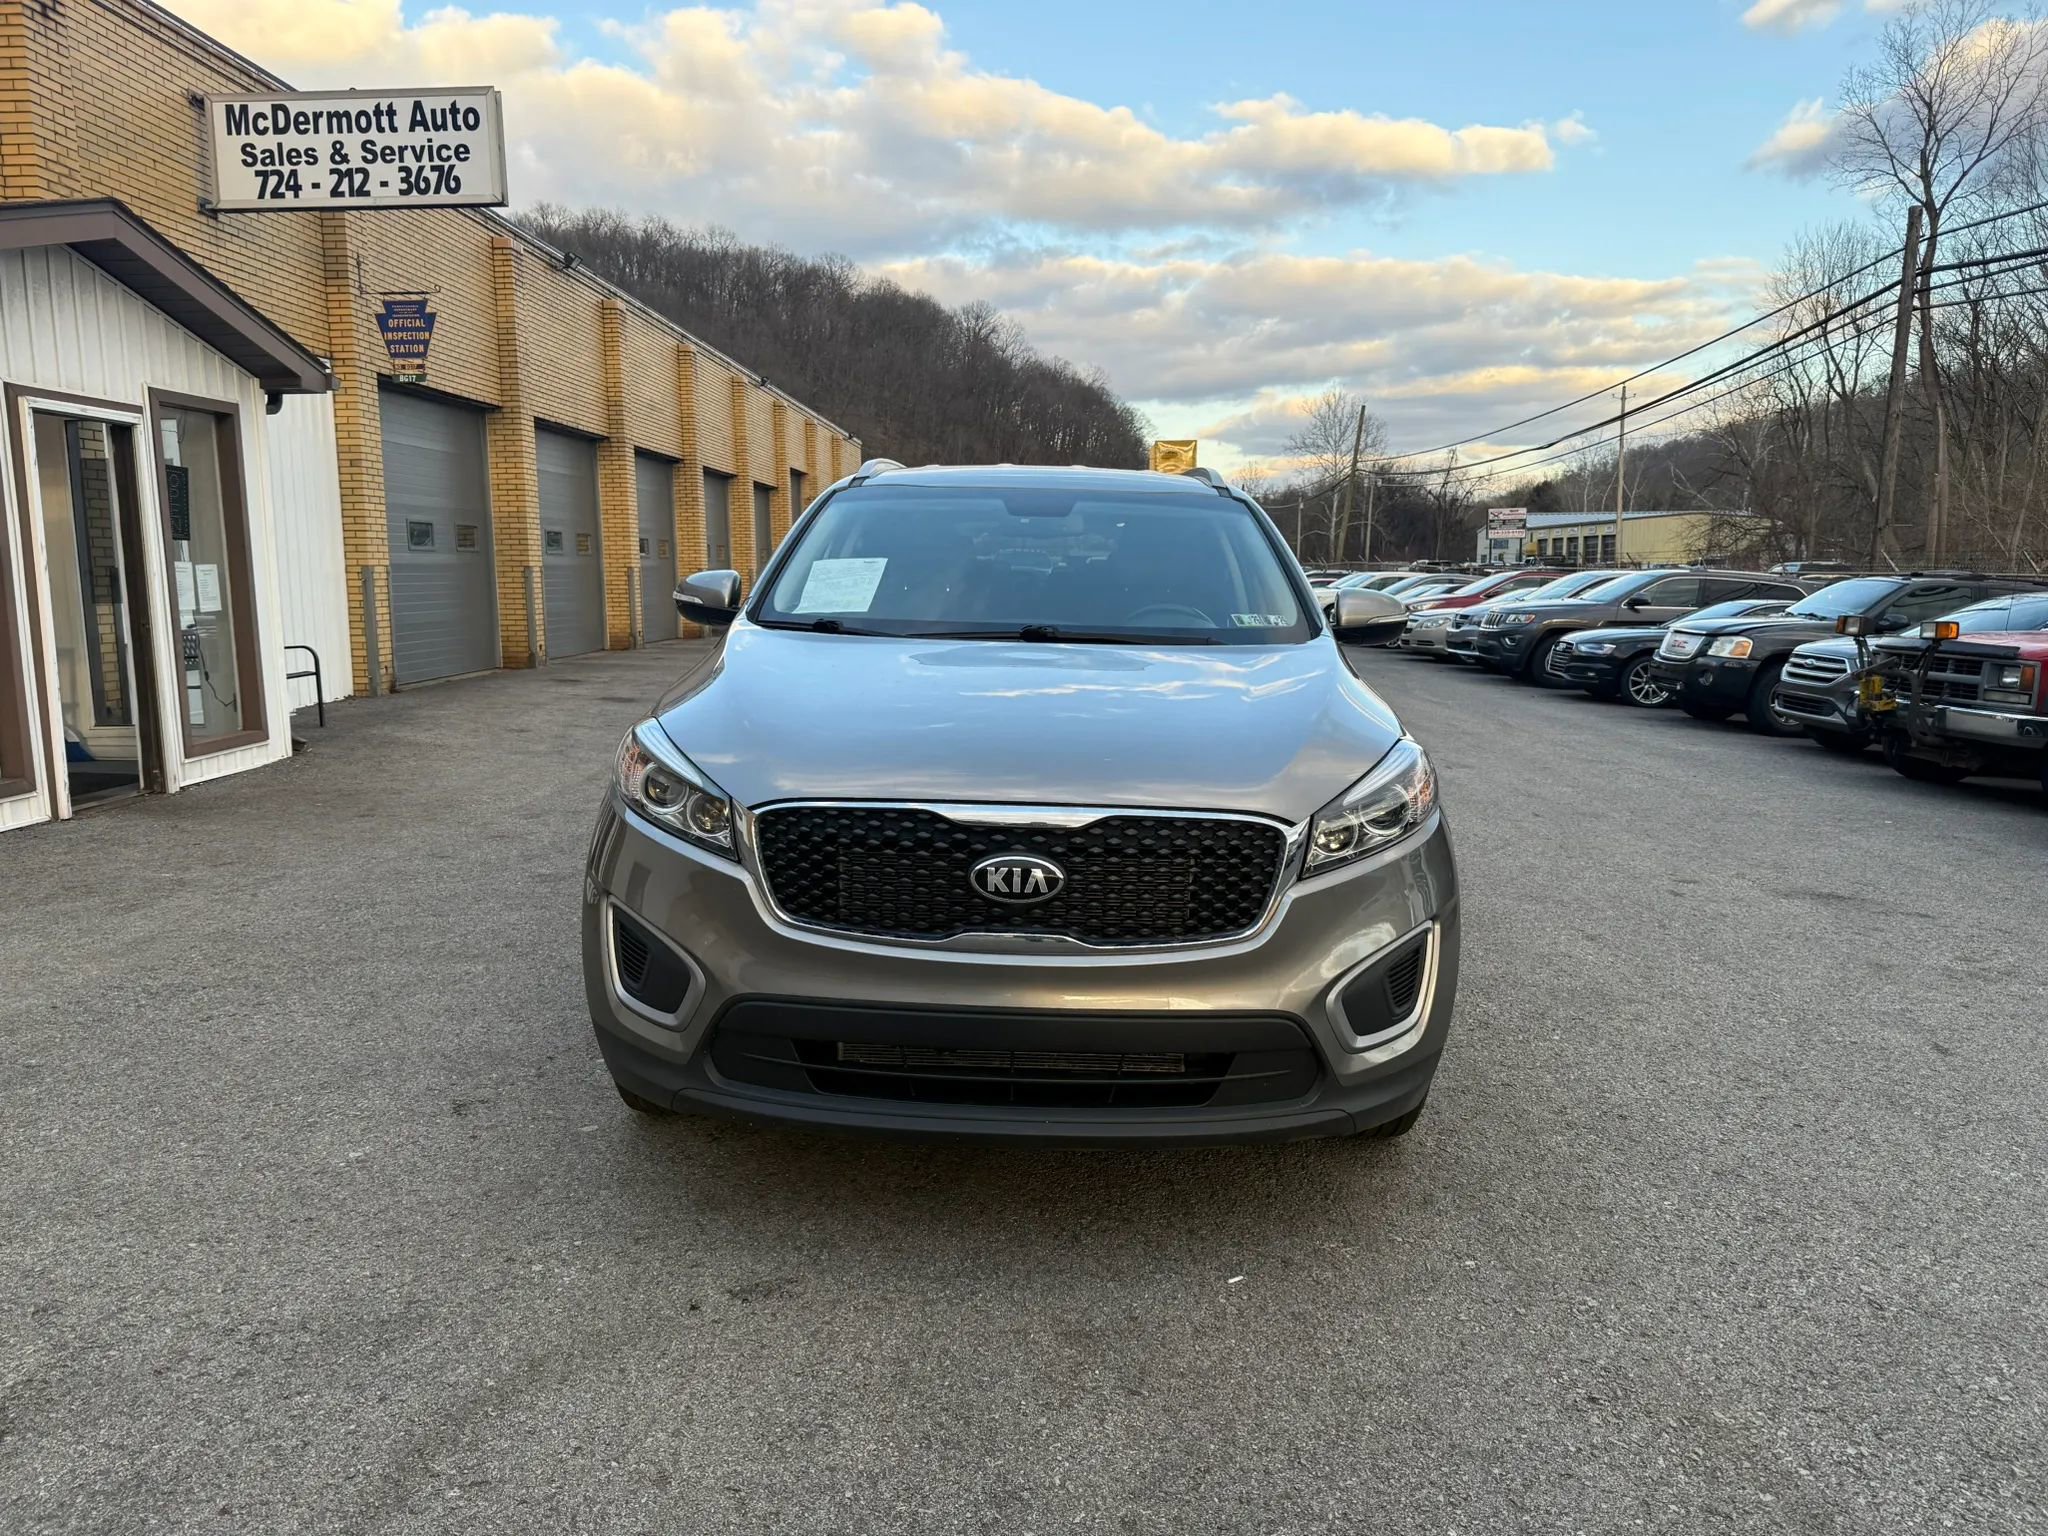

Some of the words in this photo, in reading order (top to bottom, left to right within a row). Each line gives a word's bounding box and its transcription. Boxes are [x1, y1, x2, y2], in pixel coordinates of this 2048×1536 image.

[225, 102, 398, 136] McDermott
[408, 99, 481, 132] Auto
[240, 142, 319, 168] Sales
[329, 140, 350, 165] &
[360, 138, 471, 164] Service
[254, 169, 302, 199] 724
[329, 167, 371, 198] 212
[397, 164, 462, 196] 3676
[384, 332, 430, 340] INSPECTION
[388, 319, 425, 327] OFFICIAL
[390, 344, 424, 353] STATION
[987, 867, 1048, 893] KIA
